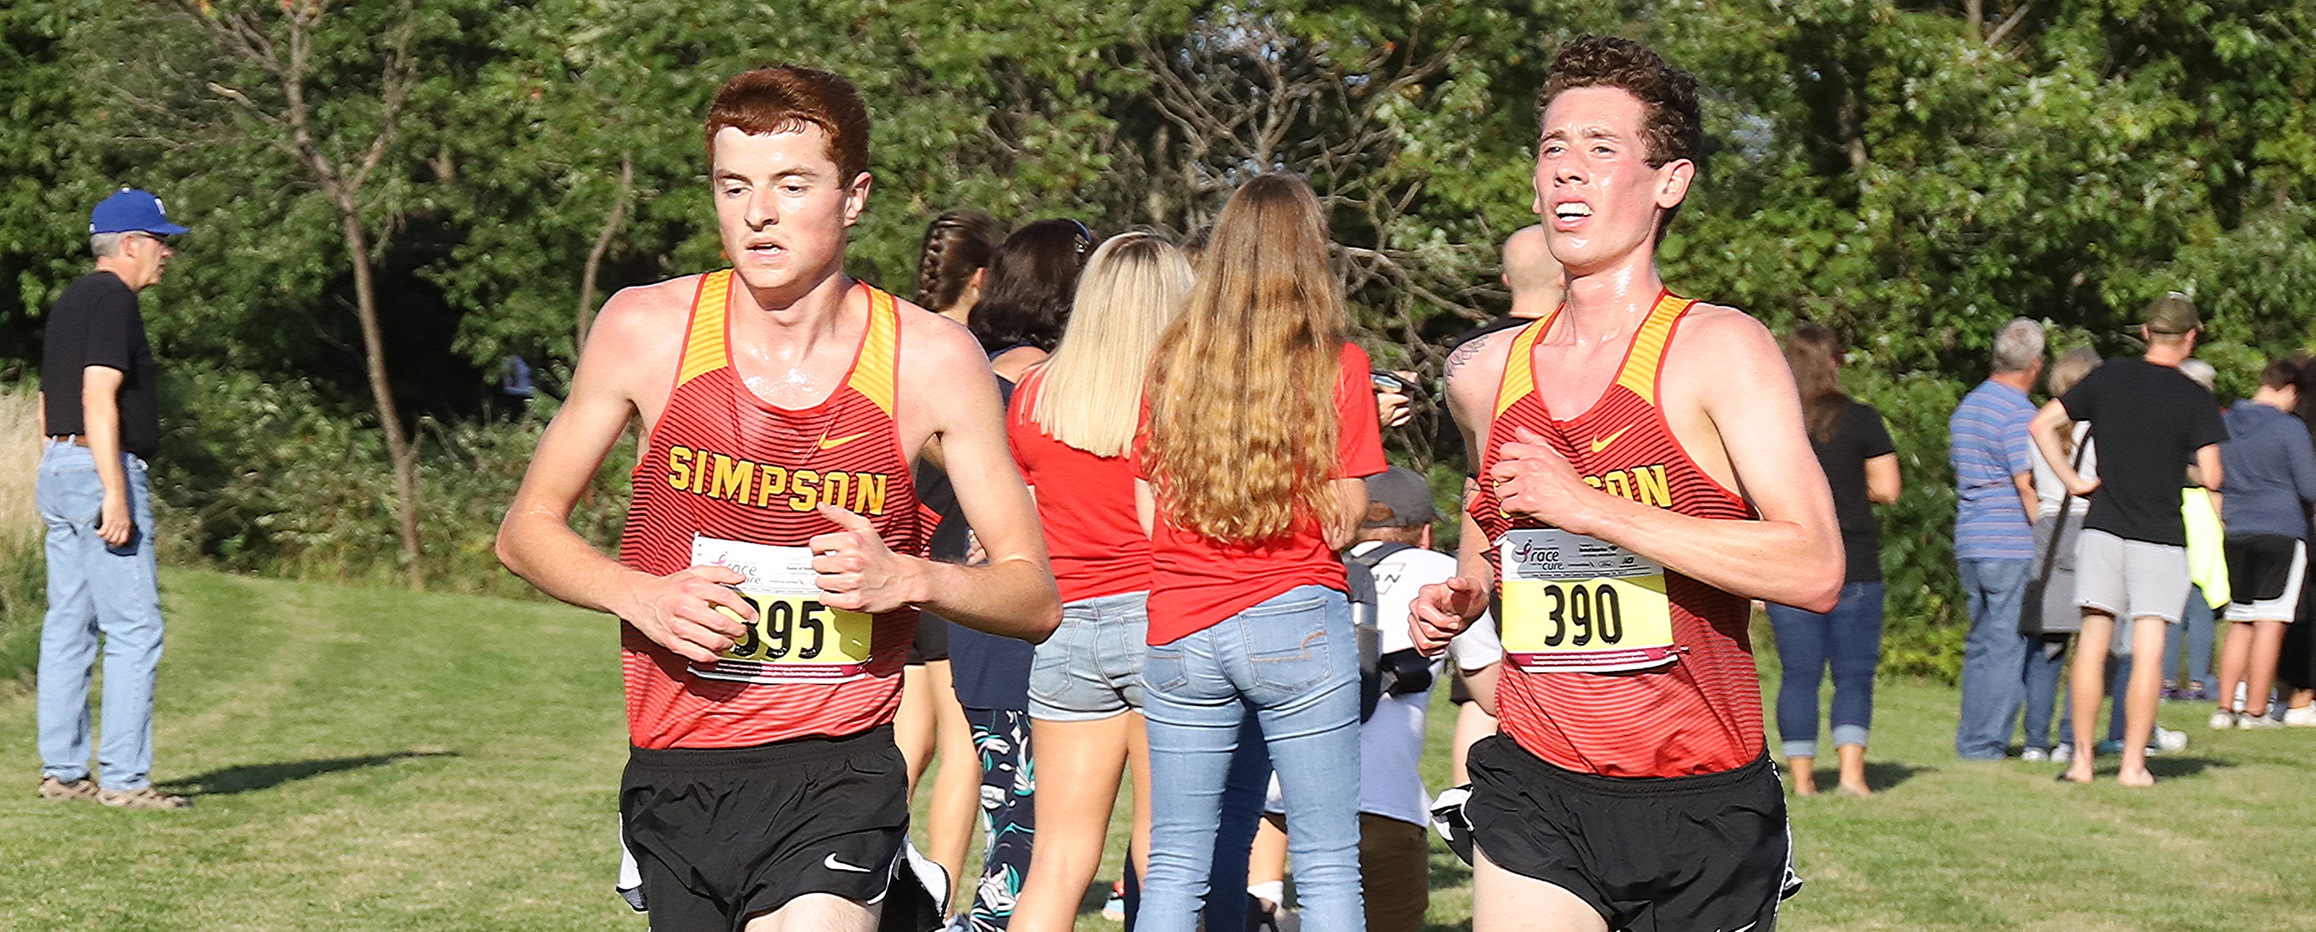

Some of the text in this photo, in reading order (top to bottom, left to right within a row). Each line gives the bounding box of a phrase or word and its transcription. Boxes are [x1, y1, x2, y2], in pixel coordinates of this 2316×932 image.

[667, 445, 888, 515] SIMPSON
[1530, 551, 1560, 562] race
[733, 596, 826, 659] 395
[1543, 584, 1624, 647] 390
